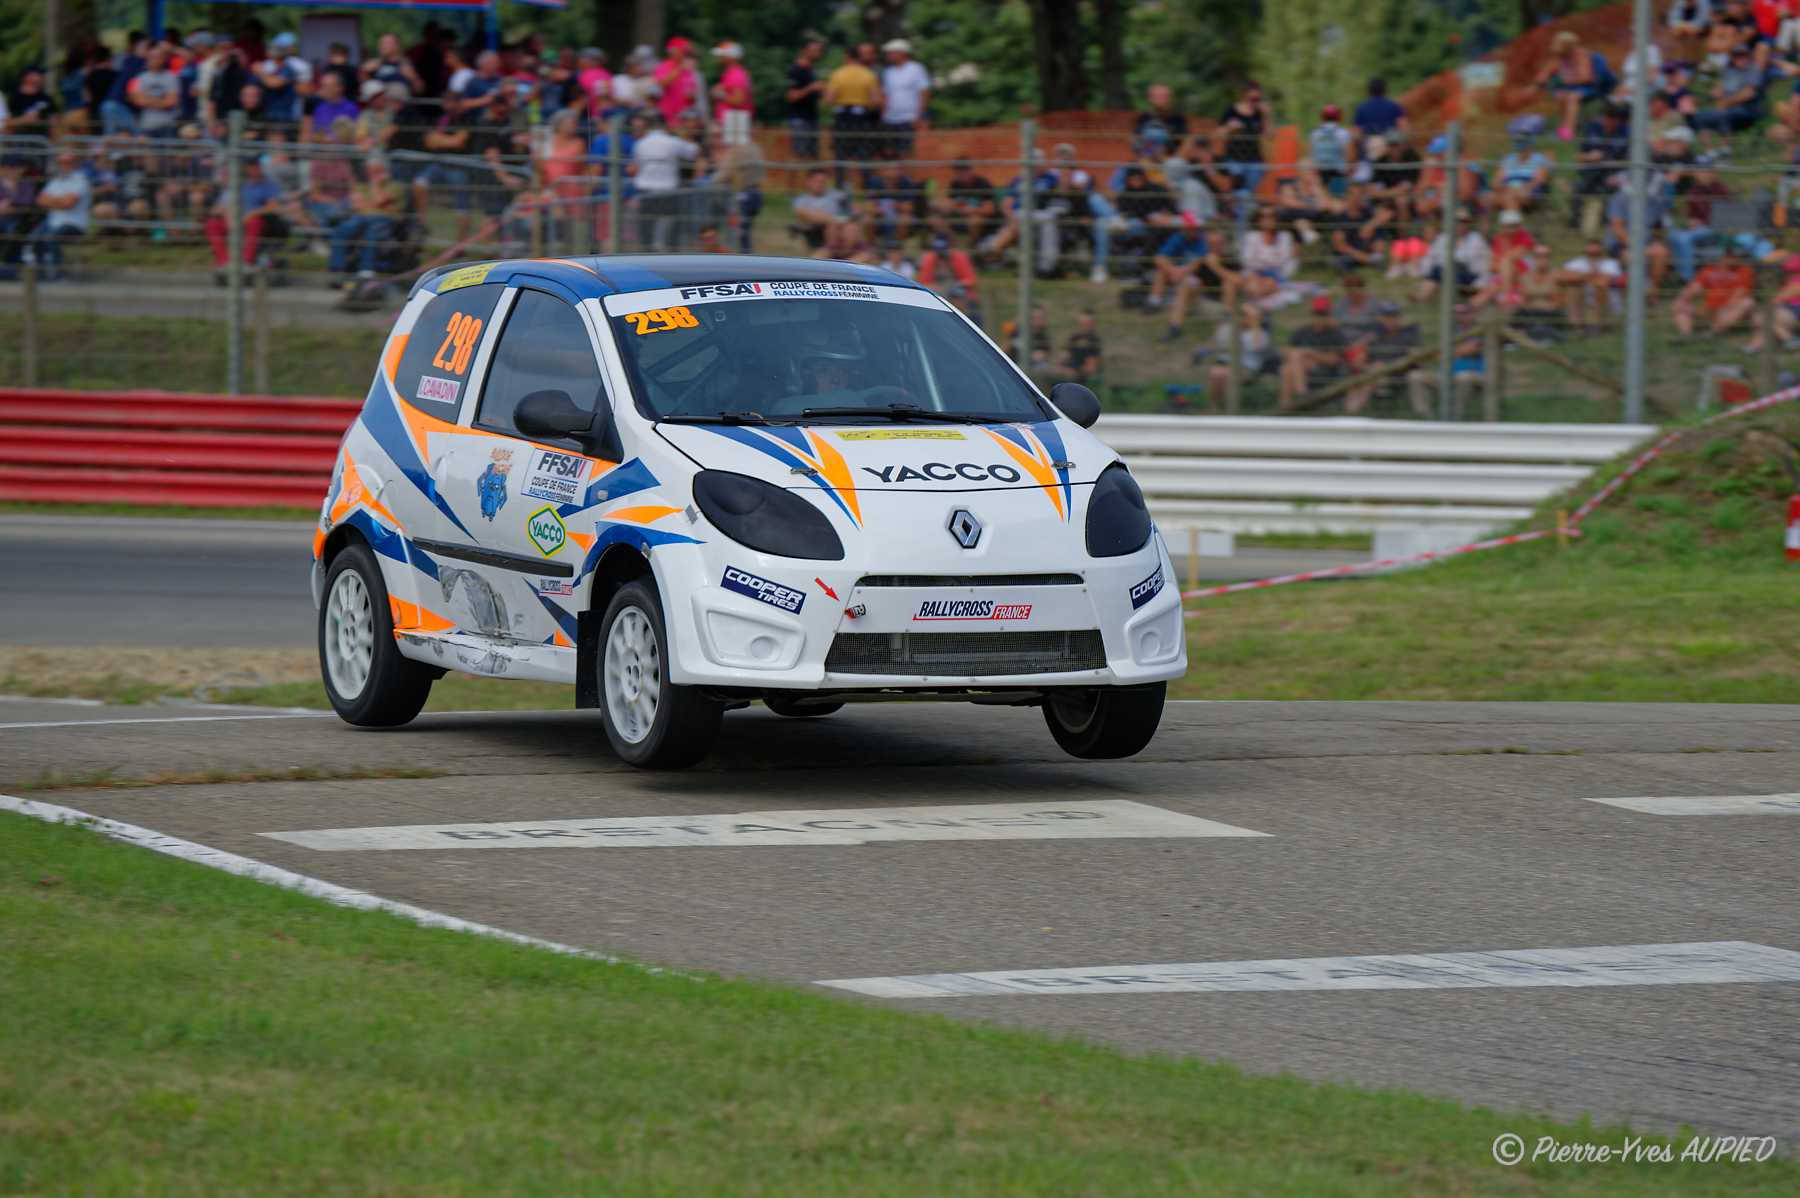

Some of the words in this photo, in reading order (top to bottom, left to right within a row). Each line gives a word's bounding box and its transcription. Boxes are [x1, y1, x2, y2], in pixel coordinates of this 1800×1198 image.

[680, 283, 754, 300] FFSA
[769, 282, 810, 290] COUPE
[830, 284, 876, 293] FRANCE
[624, 306, 700, 335] 298
[432, 311, 483, 375] 298
[537, 452, 579, 478] FFSA
[861, 462, 1021, 483] YACCO
[532, 519, 563, 543] YACCO
[725, 568, 803, 604] COOPER
[757, 590, 799, 611] TIRES
[918, 600, 994, 617] RALLYCROSS
[993, 605, 1031, 620] FRANCE
